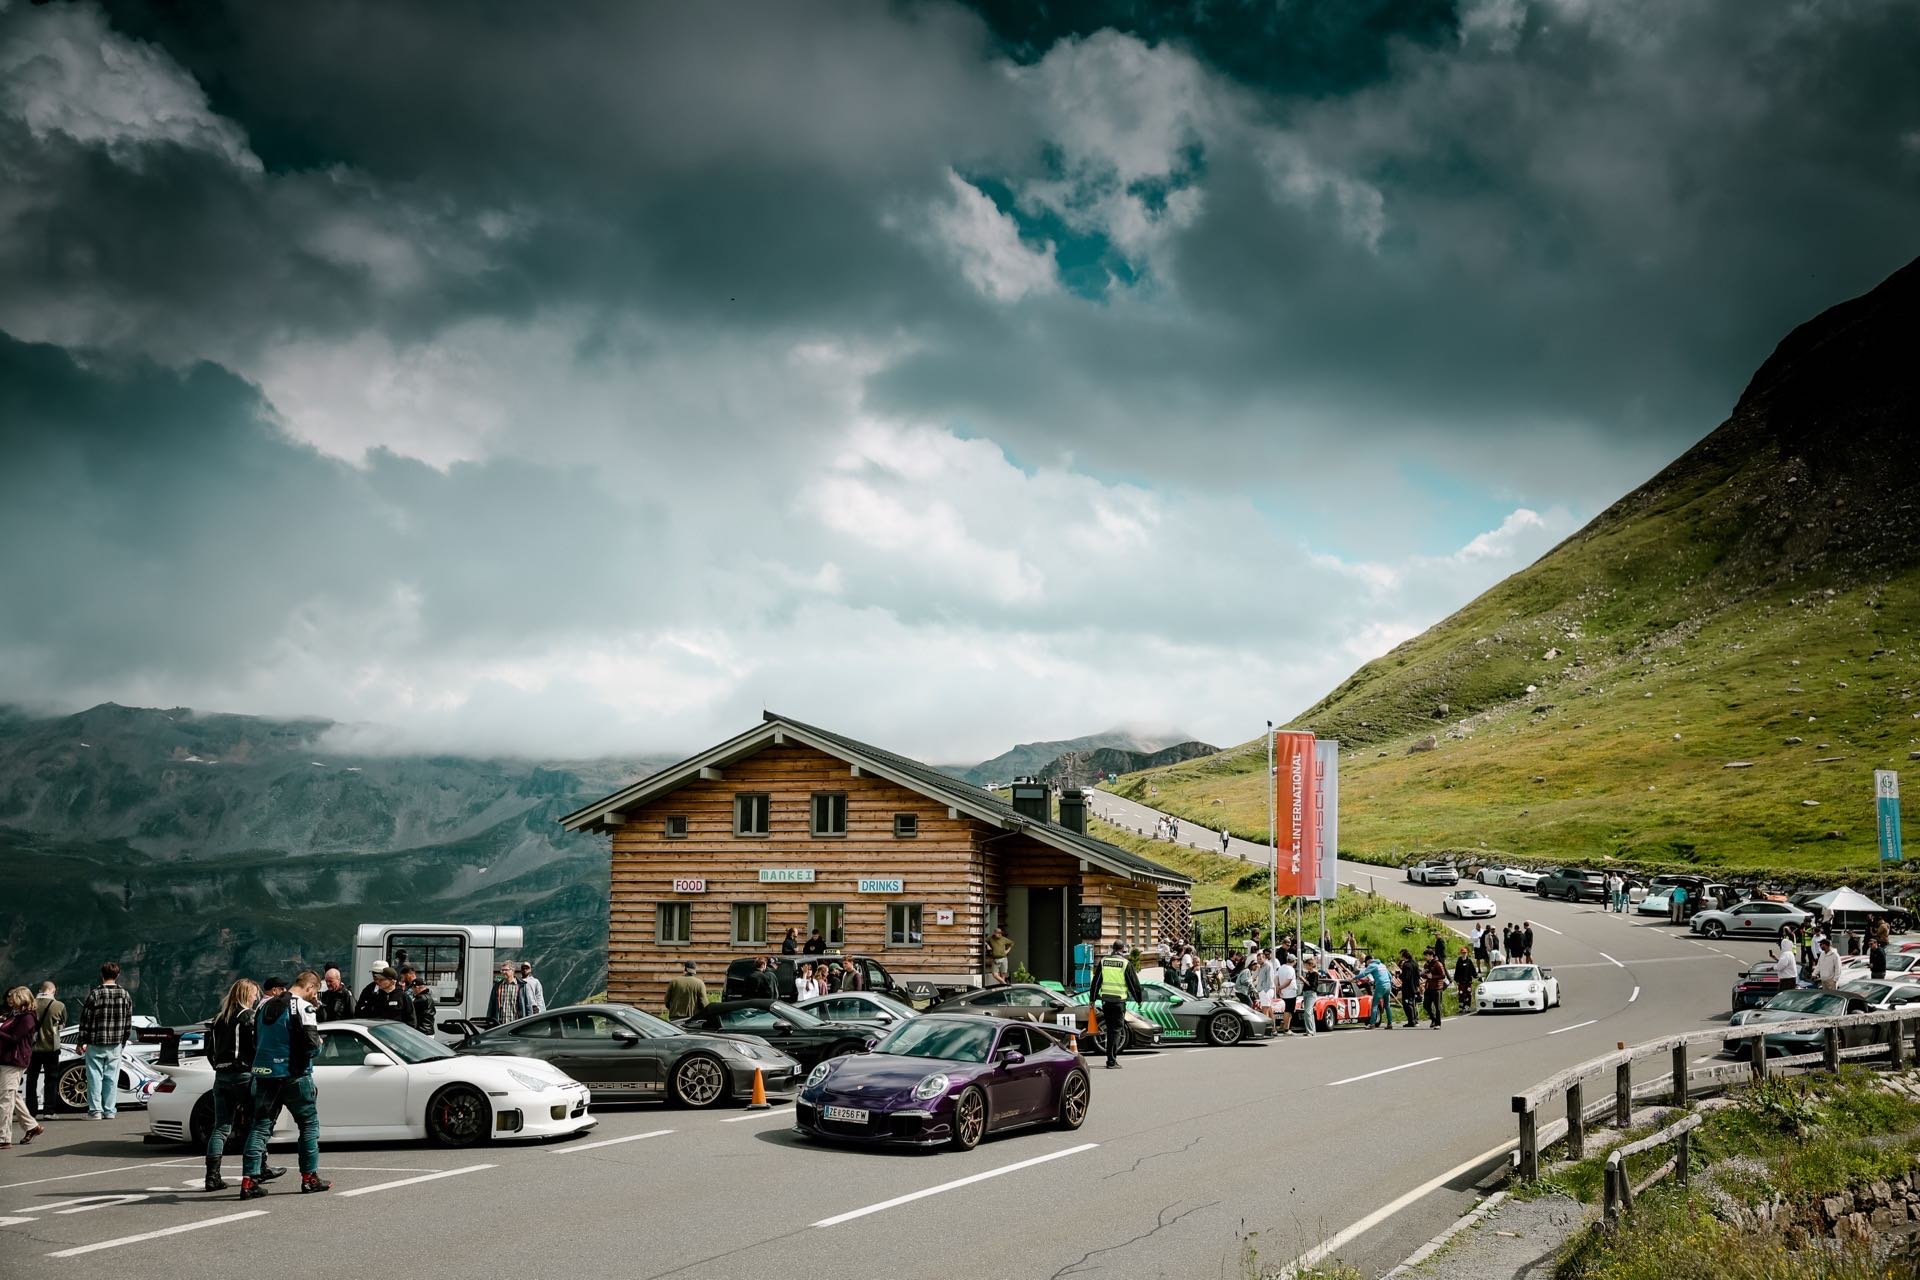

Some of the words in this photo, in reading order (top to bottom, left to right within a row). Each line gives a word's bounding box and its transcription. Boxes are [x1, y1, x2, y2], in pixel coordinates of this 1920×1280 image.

[1292, 752, 1302, 840] INTERNATIONAL
[1314, 761, 1324, 879] PORSCHE
[676, 880, 703, 891] FOOD
[862, 880, 899, 891] DRINKS
[1062, 1016, 1070, 1026] 11
[829, 1108, 837, 1117] ZE
[841, 1109, 855, 1118] 256
[855, 1111, 867, 1119] FW
